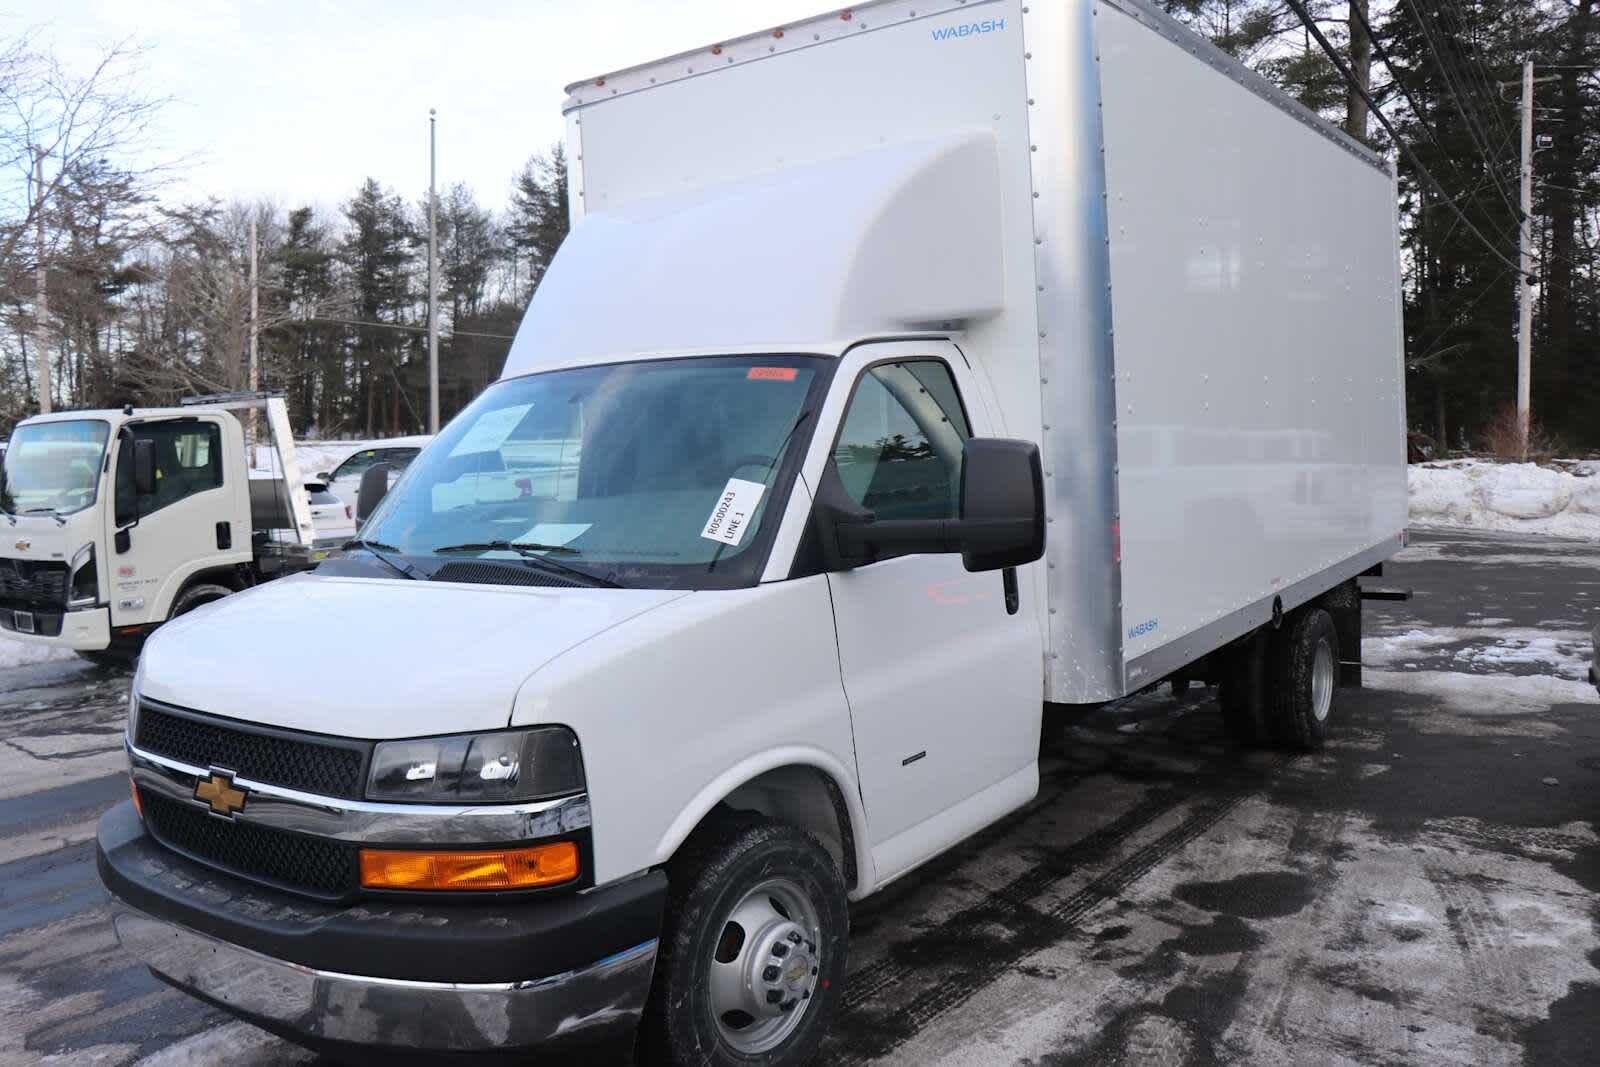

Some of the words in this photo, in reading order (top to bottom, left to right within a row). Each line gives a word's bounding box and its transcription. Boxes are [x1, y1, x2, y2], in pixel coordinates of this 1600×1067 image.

[931, 18, 1005, 41] WABASH
[707, 491, 736, 535] R0500243
[724, 519, 742, 539] LINE
[1127, 618, 1158, 639] WABASH
